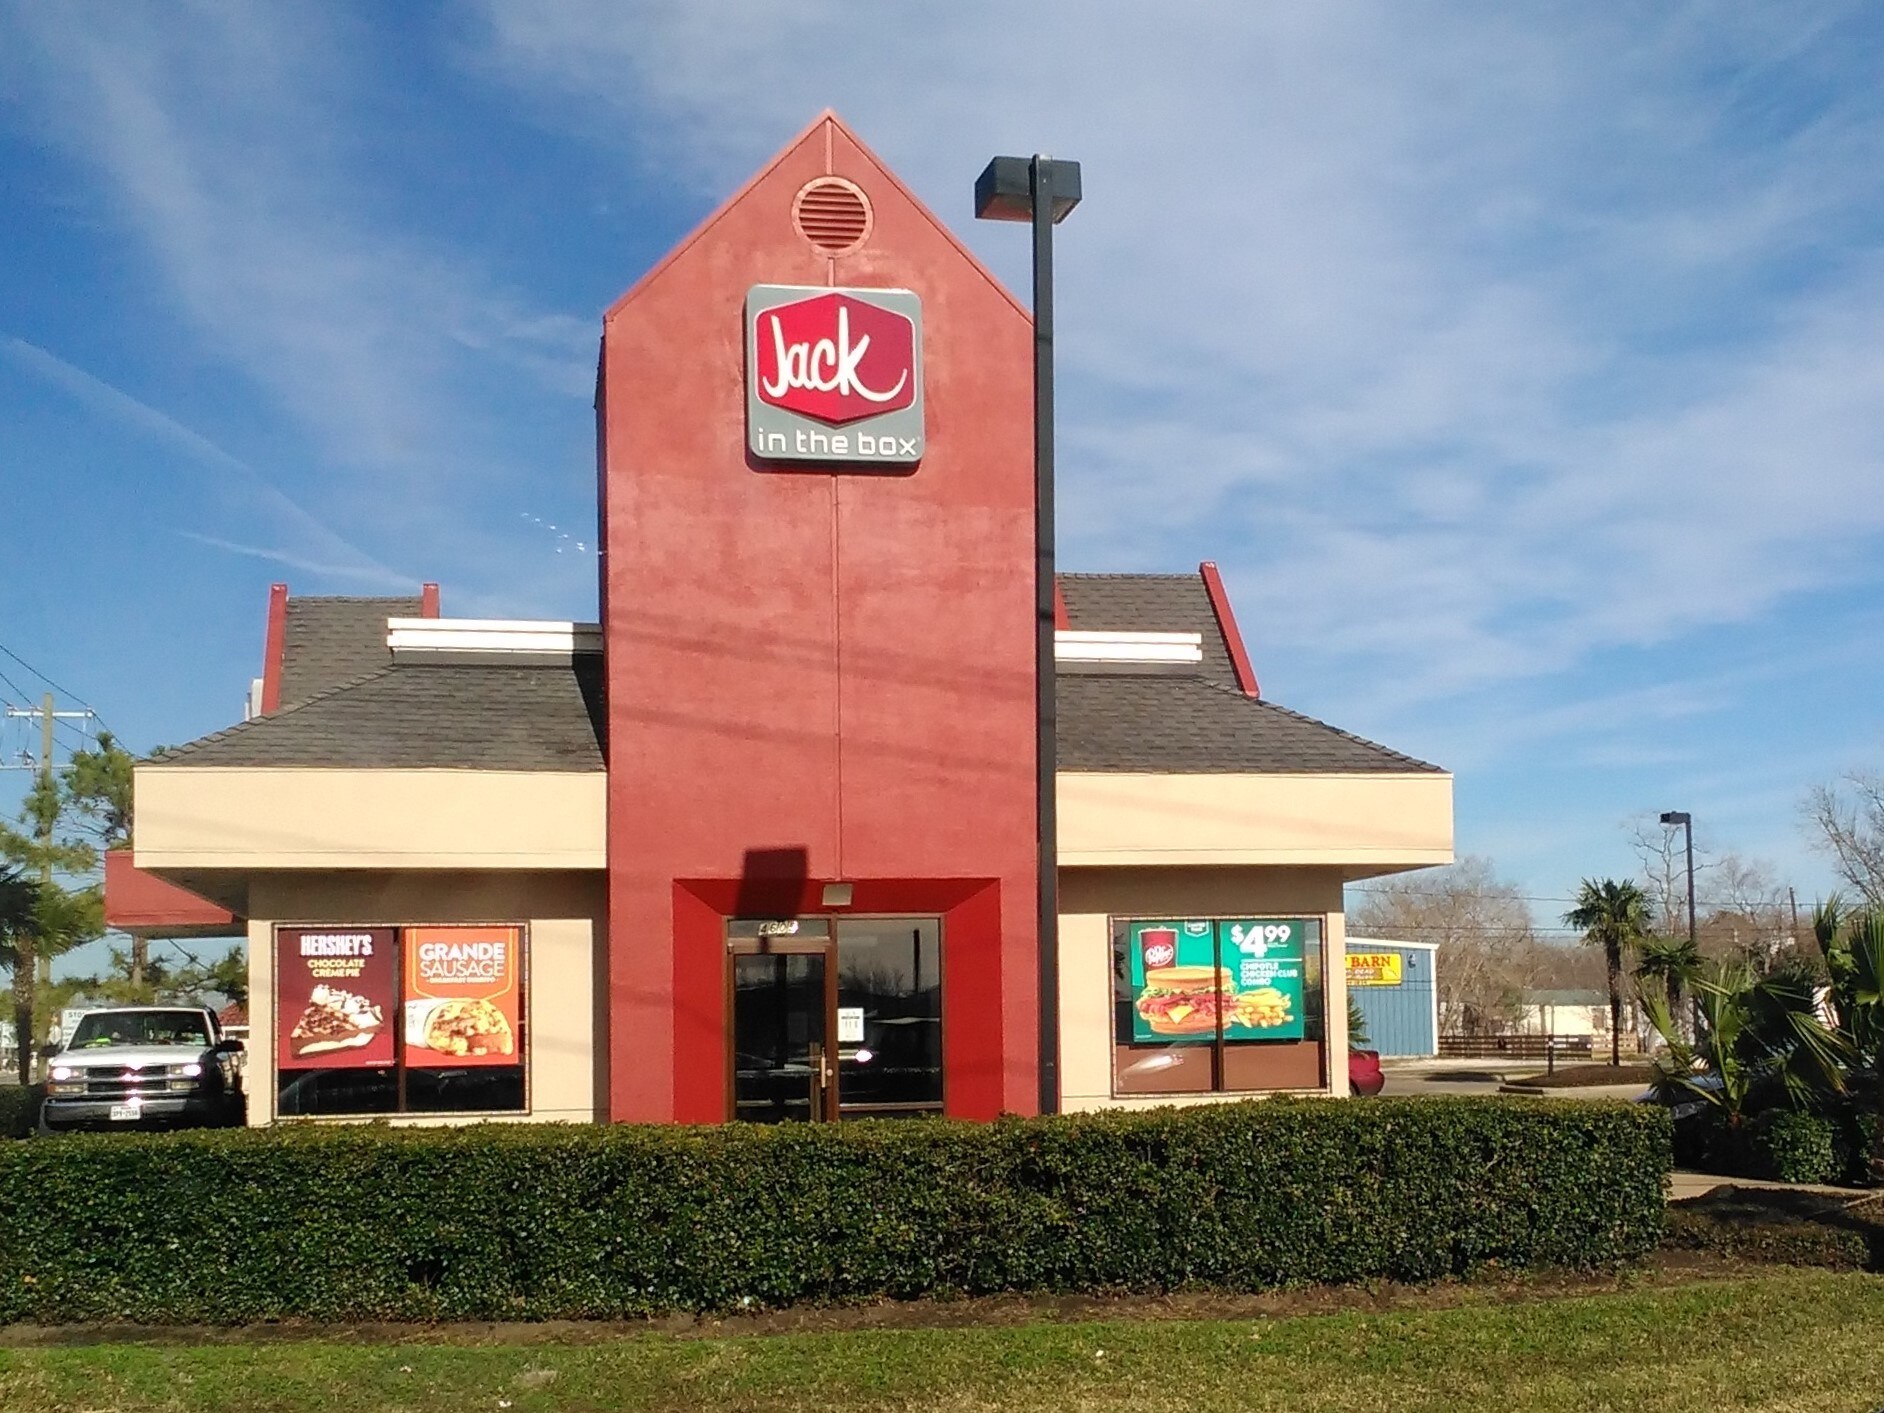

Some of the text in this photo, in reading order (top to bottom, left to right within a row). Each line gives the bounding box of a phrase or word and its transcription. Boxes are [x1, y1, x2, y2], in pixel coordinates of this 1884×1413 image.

[762, 306, 907, 402] Jack
[758, 427, 917, 456] in the box
[300, 934, 373, 956] HERSHEY'S
[419, 942, 506, 961] GRANDE
[307, 959, 366, 968] CHOCOLATE
[420, 960, 505, 977] SAUSAGE
[1351, 956, 1391, 967] BARN
[346, 968, 361, 977] PIE
[1277, 969, 1298, 978] CLUB
